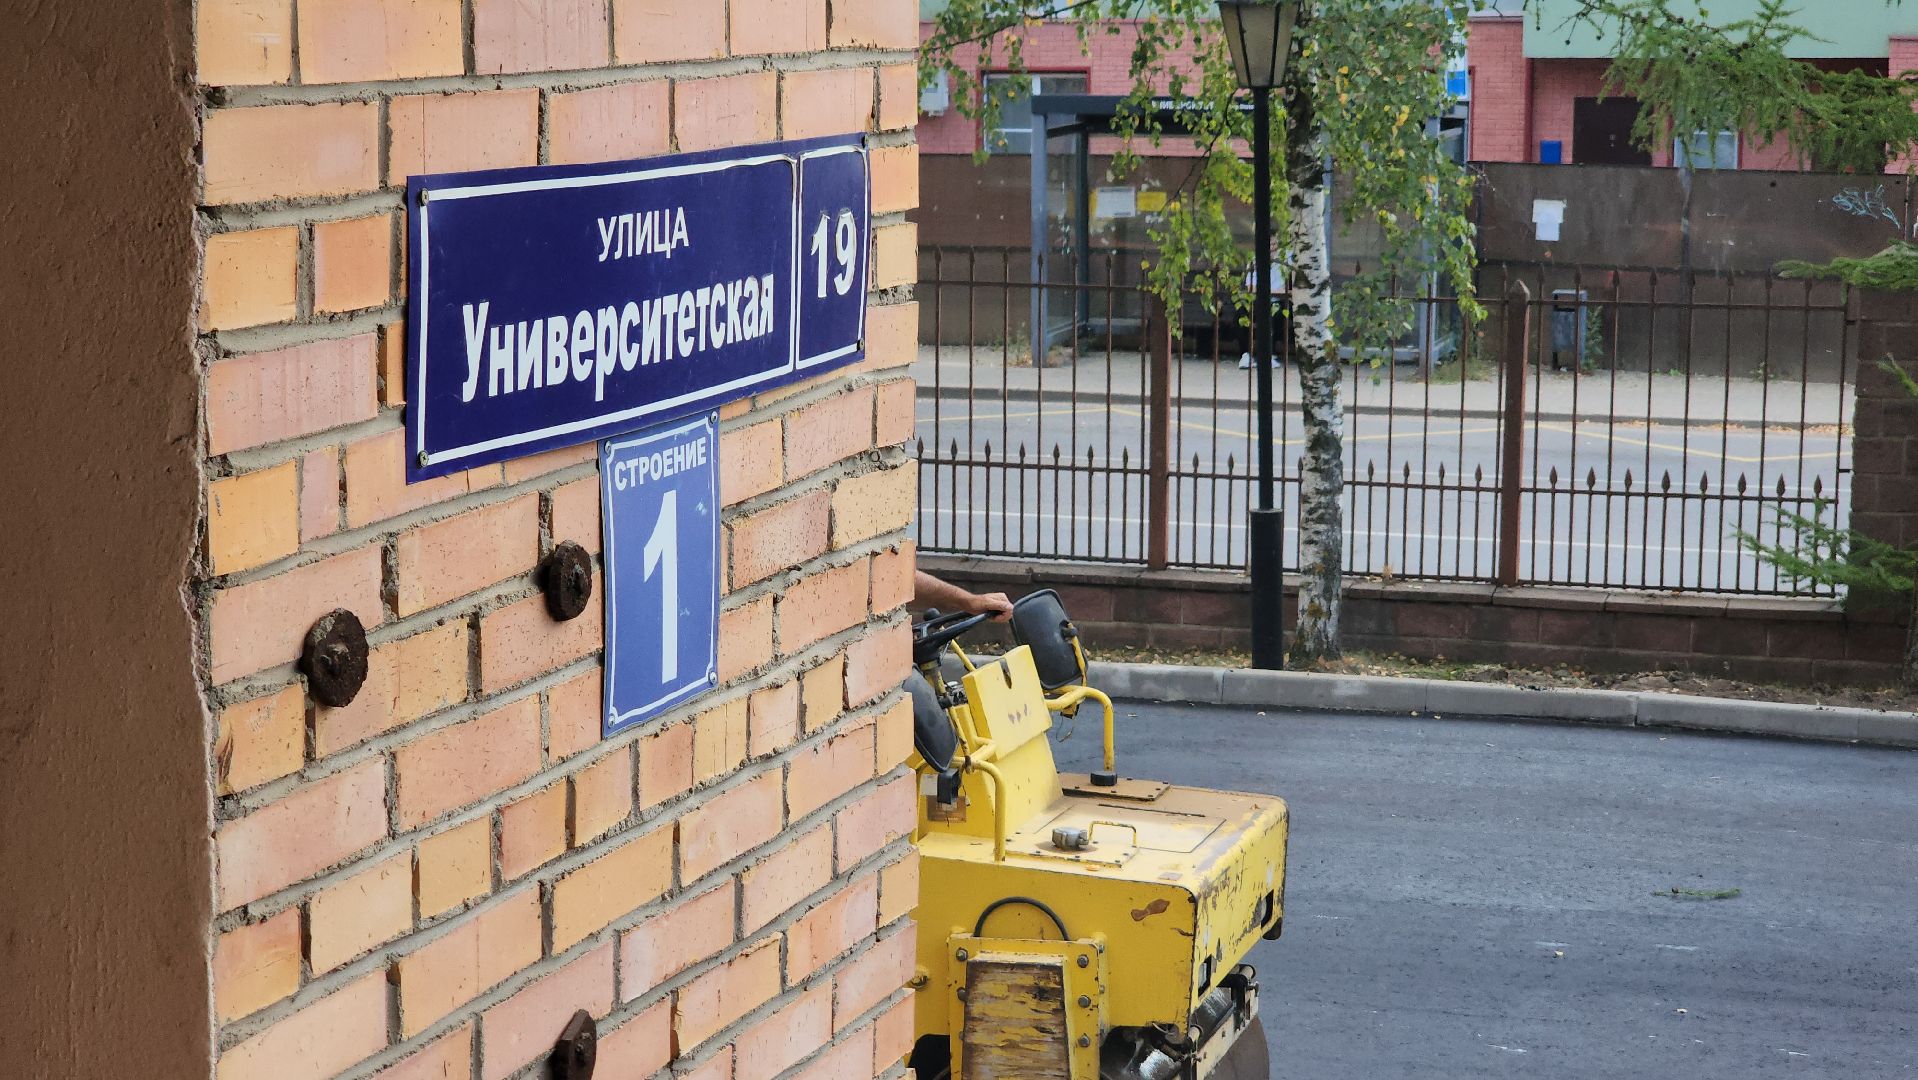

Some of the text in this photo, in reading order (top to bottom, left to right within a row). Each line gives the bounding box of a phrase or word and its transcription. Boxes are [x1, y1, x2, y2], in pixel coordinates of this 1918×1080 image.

[597, 206, 690, 262] УЛИЦА
[810, 211, 858, 299] 19
[462, 273, 775, 402] Университетская
[614, 436, 708, 491] СТРОЕНИЕ
[643, 489, 679, 685] 1
